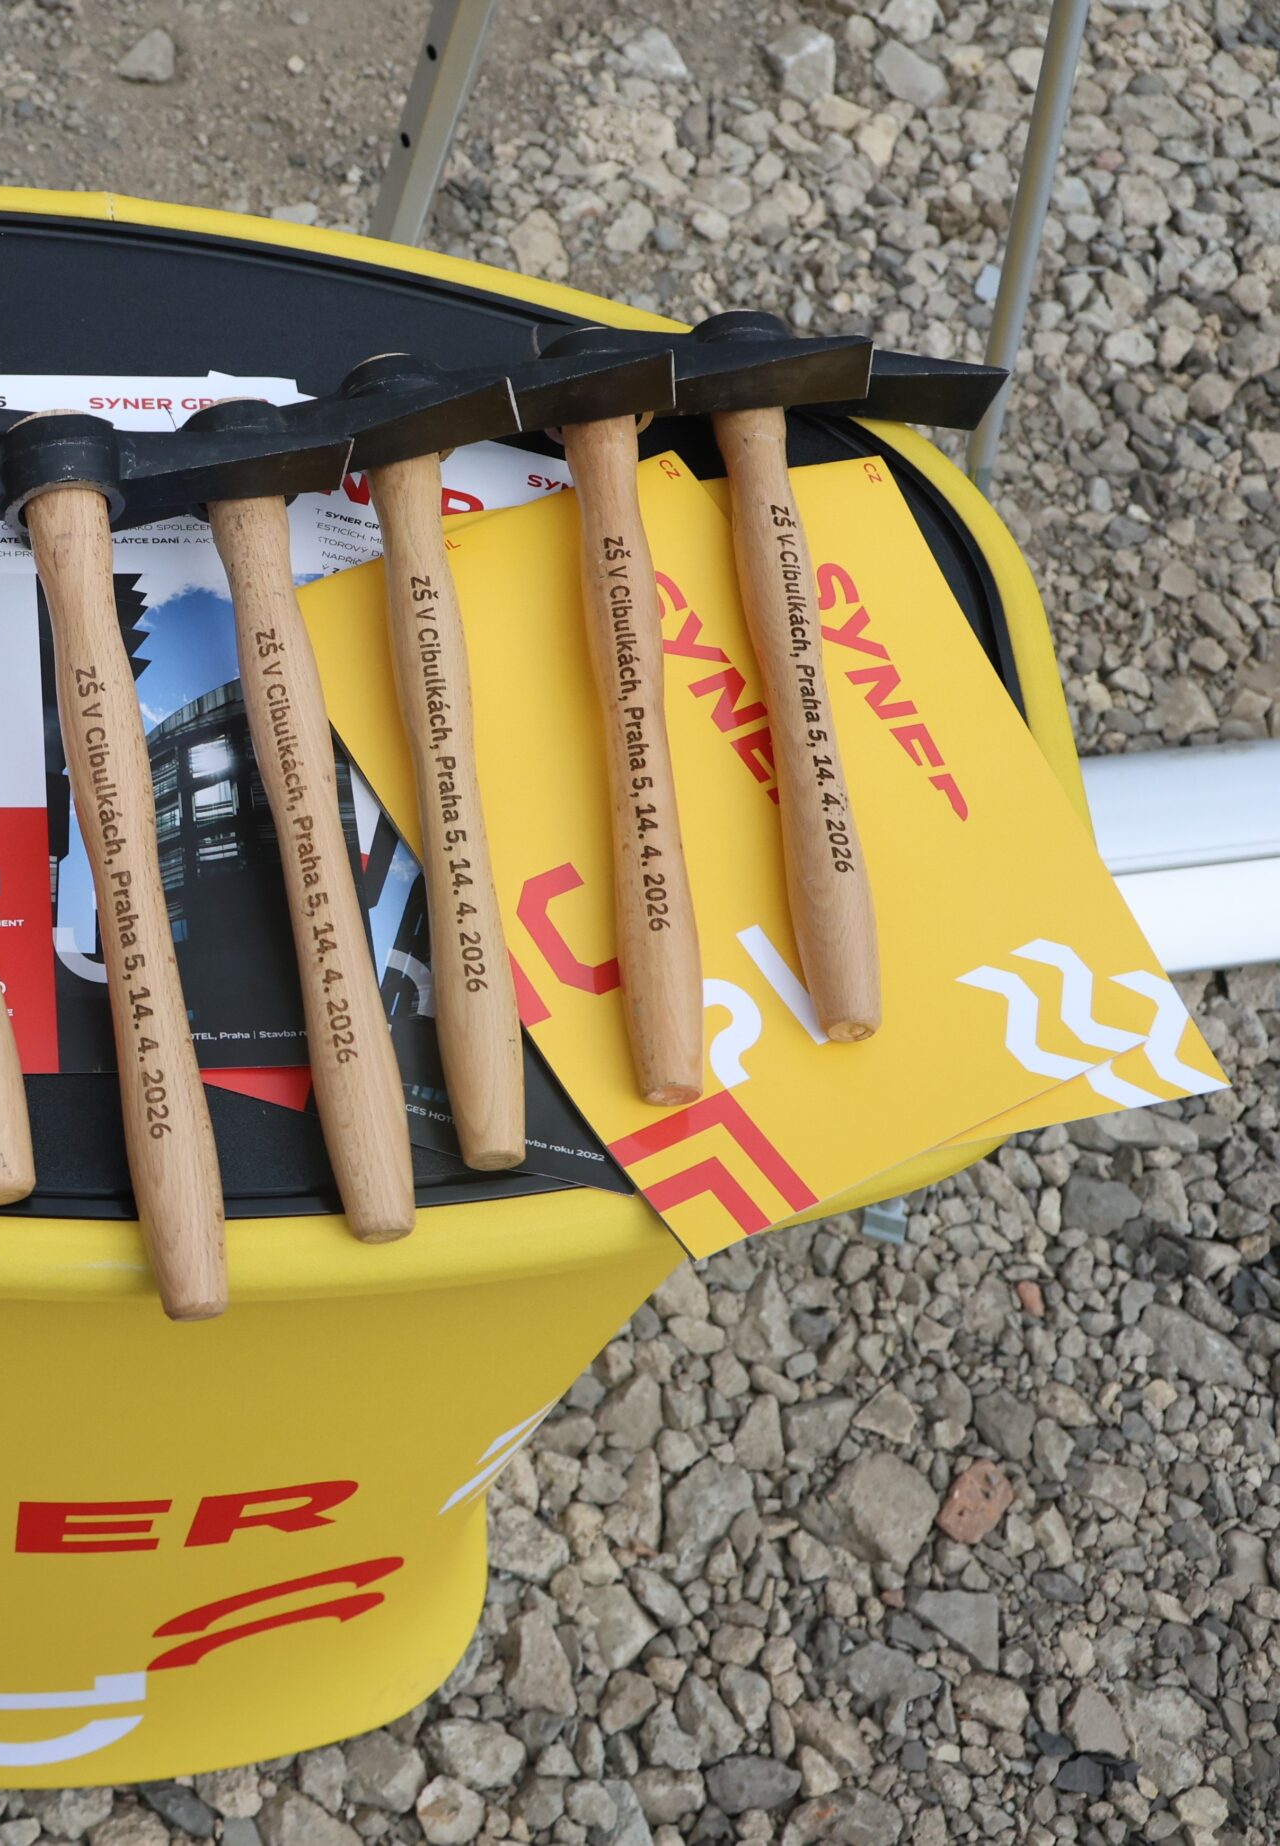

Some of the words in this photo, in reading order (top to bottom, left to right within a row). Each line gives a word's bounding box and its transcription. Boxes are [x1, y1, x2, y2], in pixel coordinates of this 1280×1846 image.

[89, 397, 172, 409] SYNER
[658, 459, 681, 479] CZ
[864, 463, 882, 483] CZ
[325, 511, 361, 525] SYNER
[770, 504, 797, 528] ZŠ
[603, 536, 632, 560] ZŠ
[777, 534, 796, 547] V
[608, 566, 628, 578] V
[410, 576, 440, 601] ZŠ
[415, 607, 436, 621] V
[780, 549, 808, 657] Cibulkách,
[256, 628, 285, 656] ZŠ
[610, 585, 638, 701] Cibulkách,
[75, 665, 106, 696] ZŠ
[262, 661, 282, 675] V
[417, 628, 456, 750] Cibulkách,
[654, 571, 780, 805] SYNE
[796, 663, 820, 723] Praha
[81, 703, 102, 718] V
[267, 683, 306, 812] Cibulkách,
[624, 706, 648, 771] Praha
[806, 728, 827, 747] 5,
[813, 755, 835, 786] 14.
[85, 727, 124, 865] Cibulkách,
[436, 756, 459, 824] Praha
[632, 776, 653, 798] 5,
[821, 792, 840, 813] 4.
[635, 804, 658, 839] 14.
[292, 816, 318, 887] Praha
[445, 829, 467, 852] 5,
[826, 819, 855, 873] 2026
[641, 844, 662, 867] 4.
[449, 858, 473, 896] 14.
[110, 870, 137, 949] Praha
[303, 892, 329, 918] 5,
[456, 901, 477, 925] 4.
[643, 873, 671, 932] 2026
[313, 922, 338, 963] 14.
[122, 954, 146, 980] 5,
[460, 931, 488, 993] 2026
[321, 968, 343, 993] 4.
[129, 986, 154, 1029] 14.
[259, 1030, 296, 1038] Stavba
[327, 997, 358, 1065] 2026
[136, 1034, 159, 1062] 4.
[144, 1070, 172, 1139] 2026
[550, 1144, 574, 1155] roku
[576, 1150, 605, 1162] 2022
